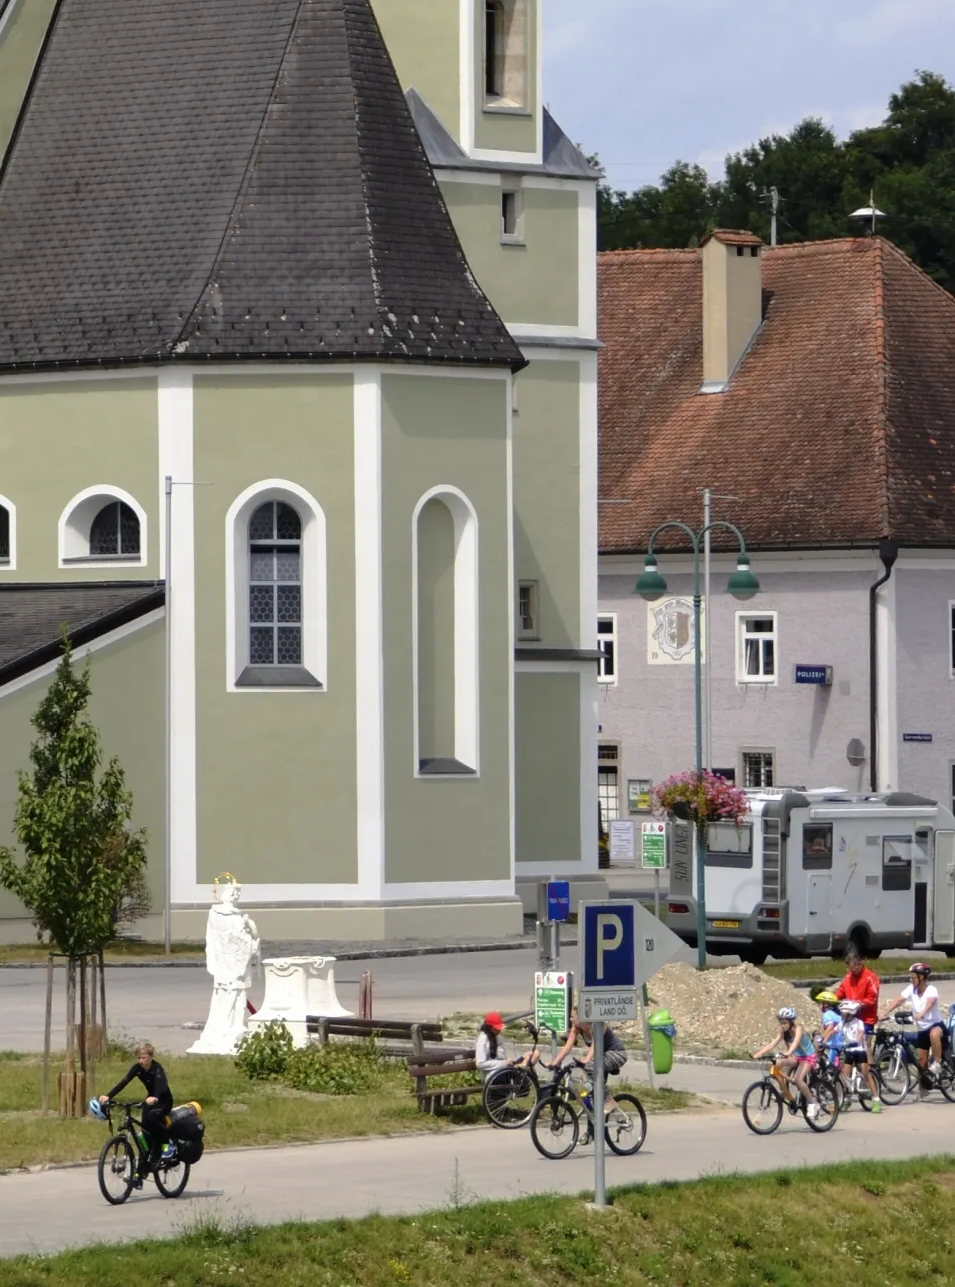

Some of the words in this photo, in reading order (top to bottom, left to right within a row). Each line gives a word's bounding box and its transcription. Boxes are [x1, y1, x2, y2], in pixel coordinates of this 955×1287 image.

[674, 860, 688, 882] SUN
[597, 914, 623, 979] P
[594, 996, 634, 1006] PRIVATLÄNDE
[599, 1008, 617, 1016] LAND
